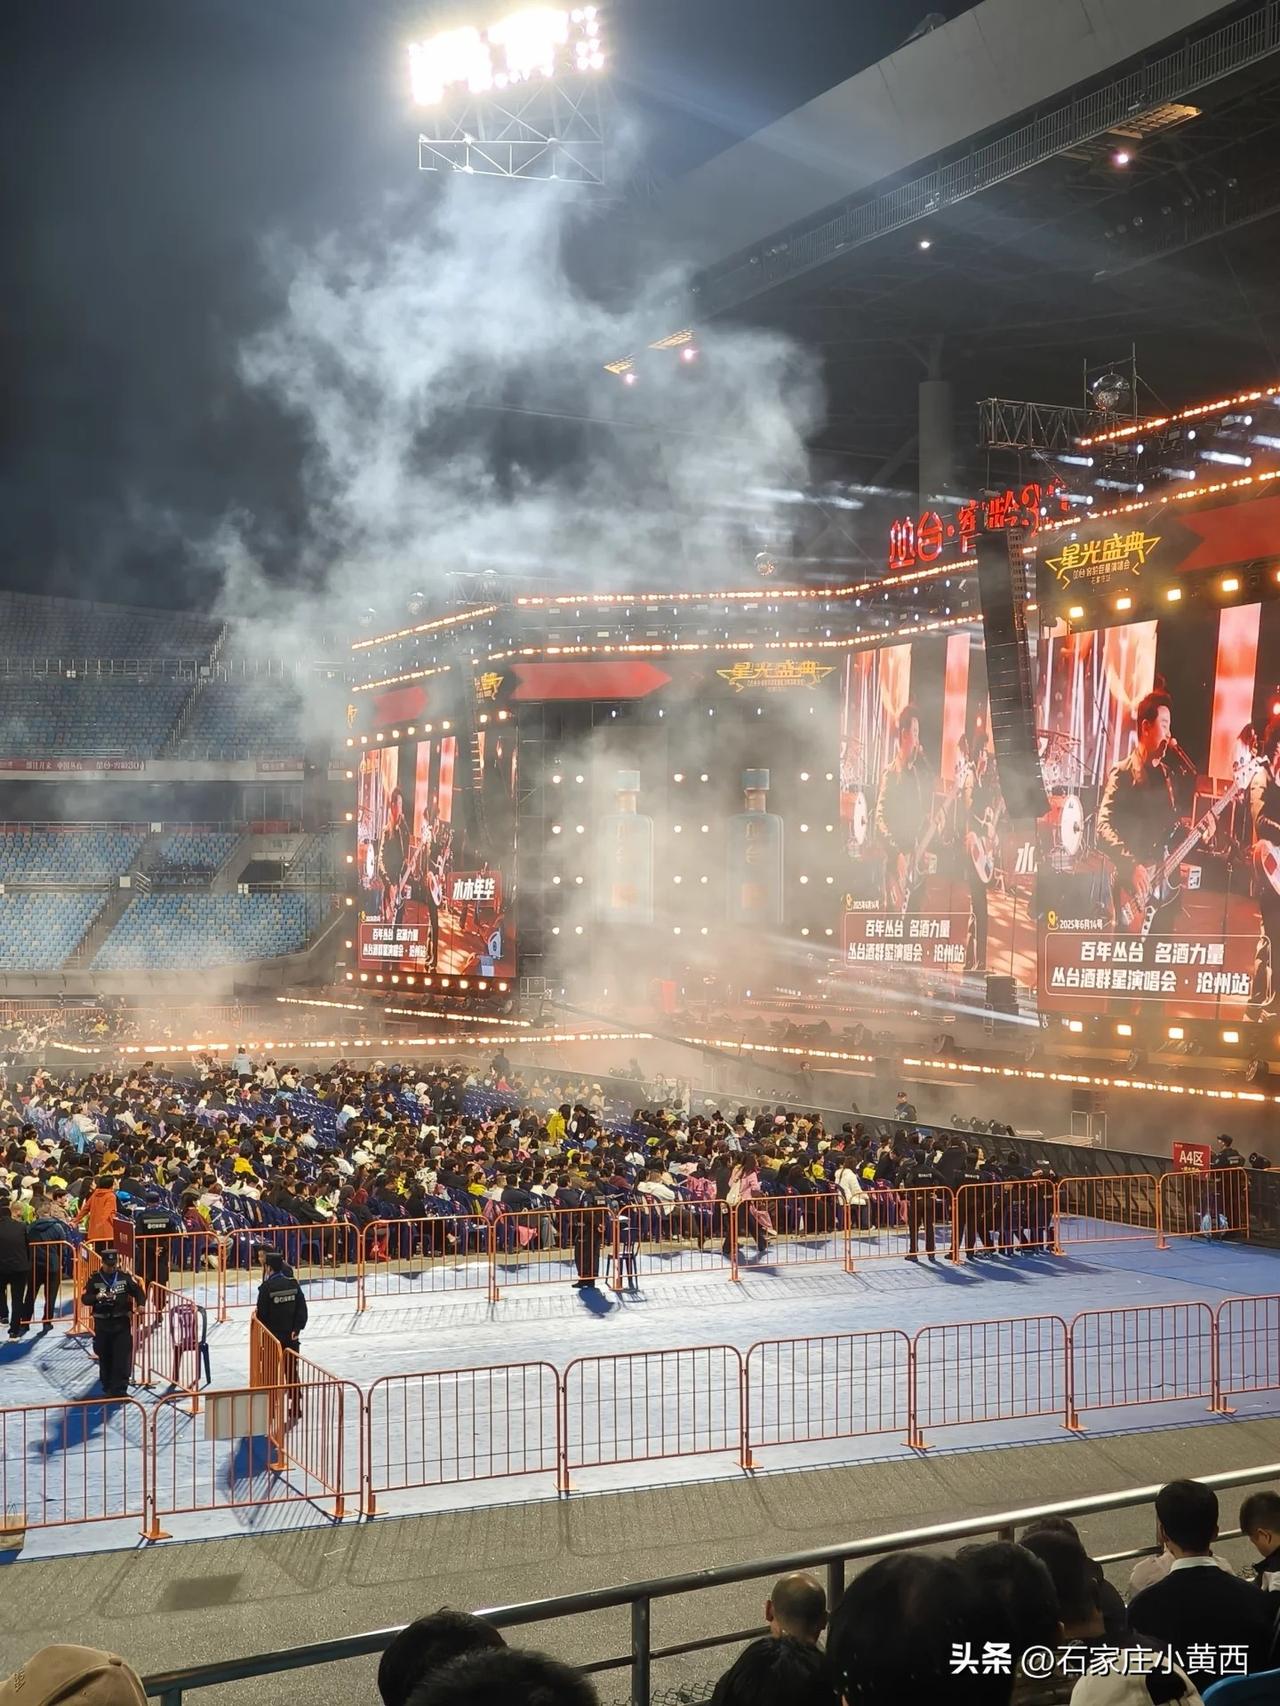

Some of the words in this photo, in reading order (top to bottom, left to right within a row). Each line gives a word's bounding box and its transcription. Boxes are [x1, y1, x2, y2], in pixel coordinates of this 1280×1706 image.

[1058, 531, 1146, 575] 星光盛典
[453, 878, 496, 900] 水木年华
[866, 920, 904, 938] 百年丛台
[909, 920, 950, 938] 名酒力量
[1060, 918, 1103, 929] 2025年6月14号
[1080, 942, 1144, 962] 百年丛台
[1155, 943, 1225, 965] 名酒力量
[1179, 1150, 1204, 1166] A4区
